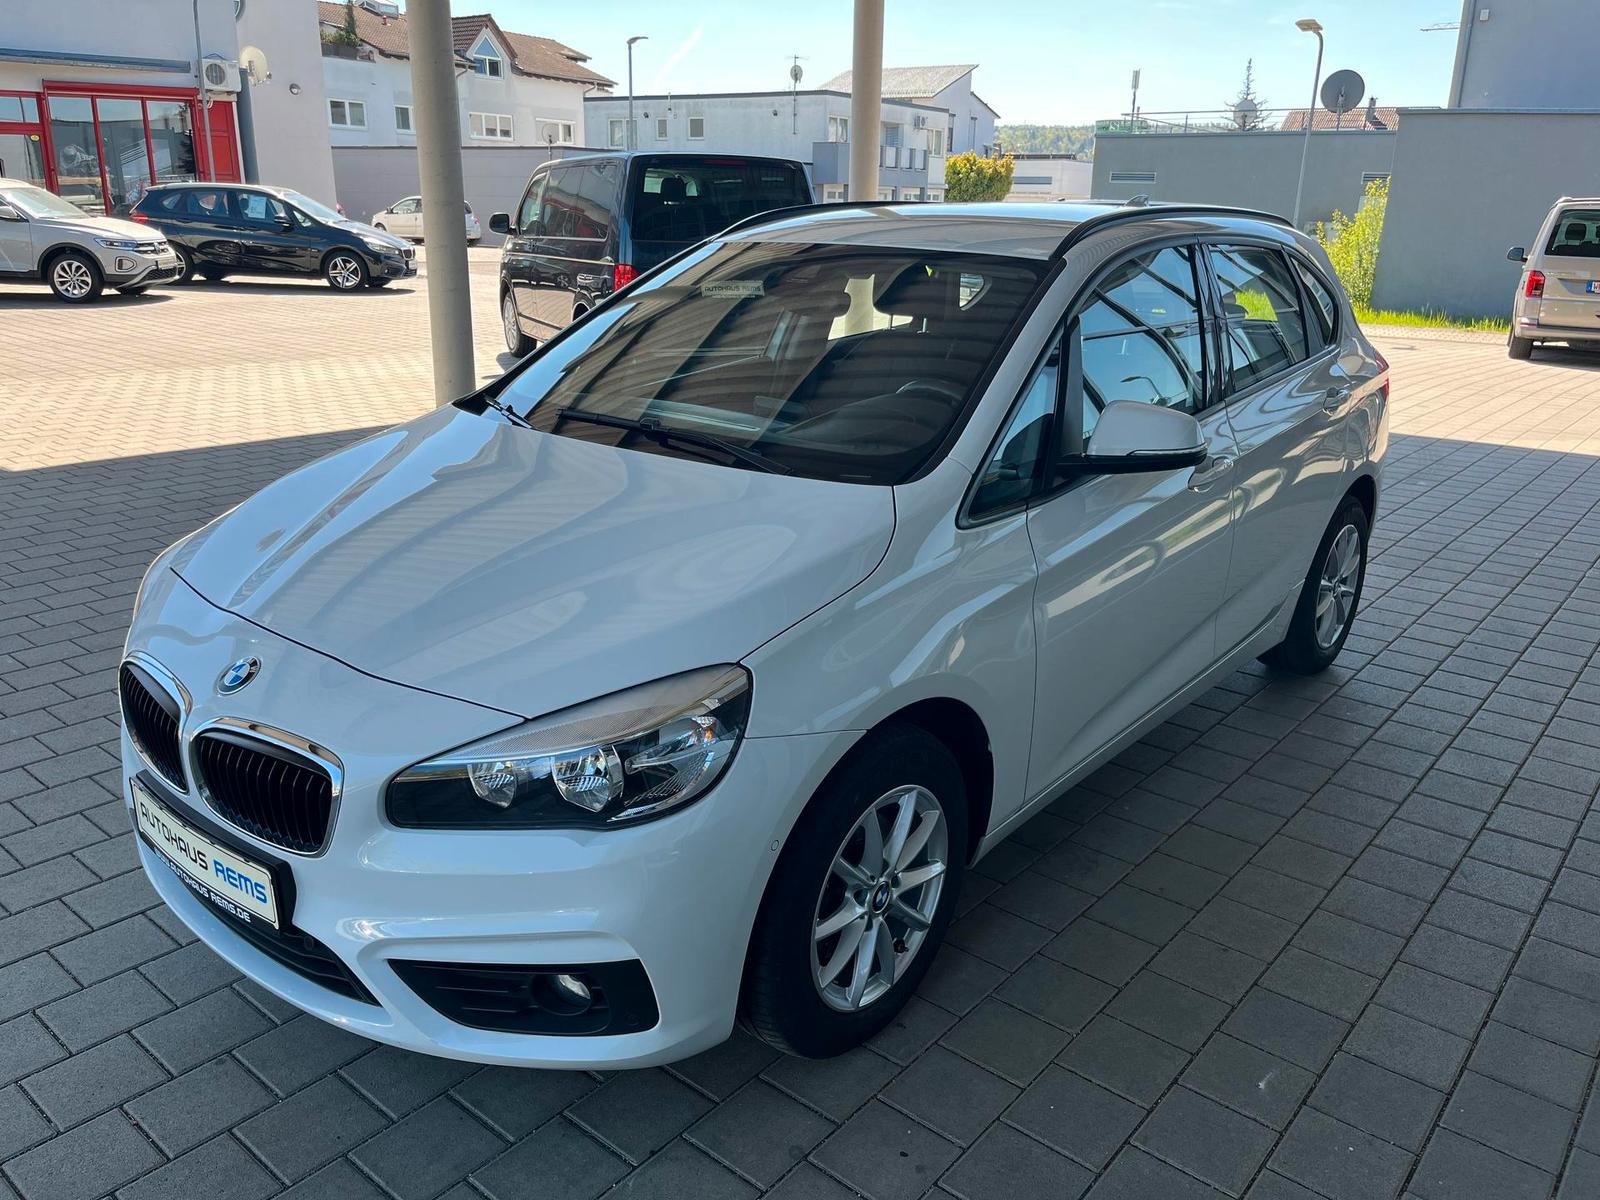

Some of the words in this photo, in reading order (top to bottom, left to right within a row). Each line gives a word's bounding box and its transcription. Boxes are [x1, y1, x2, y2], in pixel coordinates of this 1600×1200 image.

[140, 802, 208, 870] AUTOHAUS
[213, 859, 267, 903] REMS
[210, 892, 251, 922] REMS.DE
